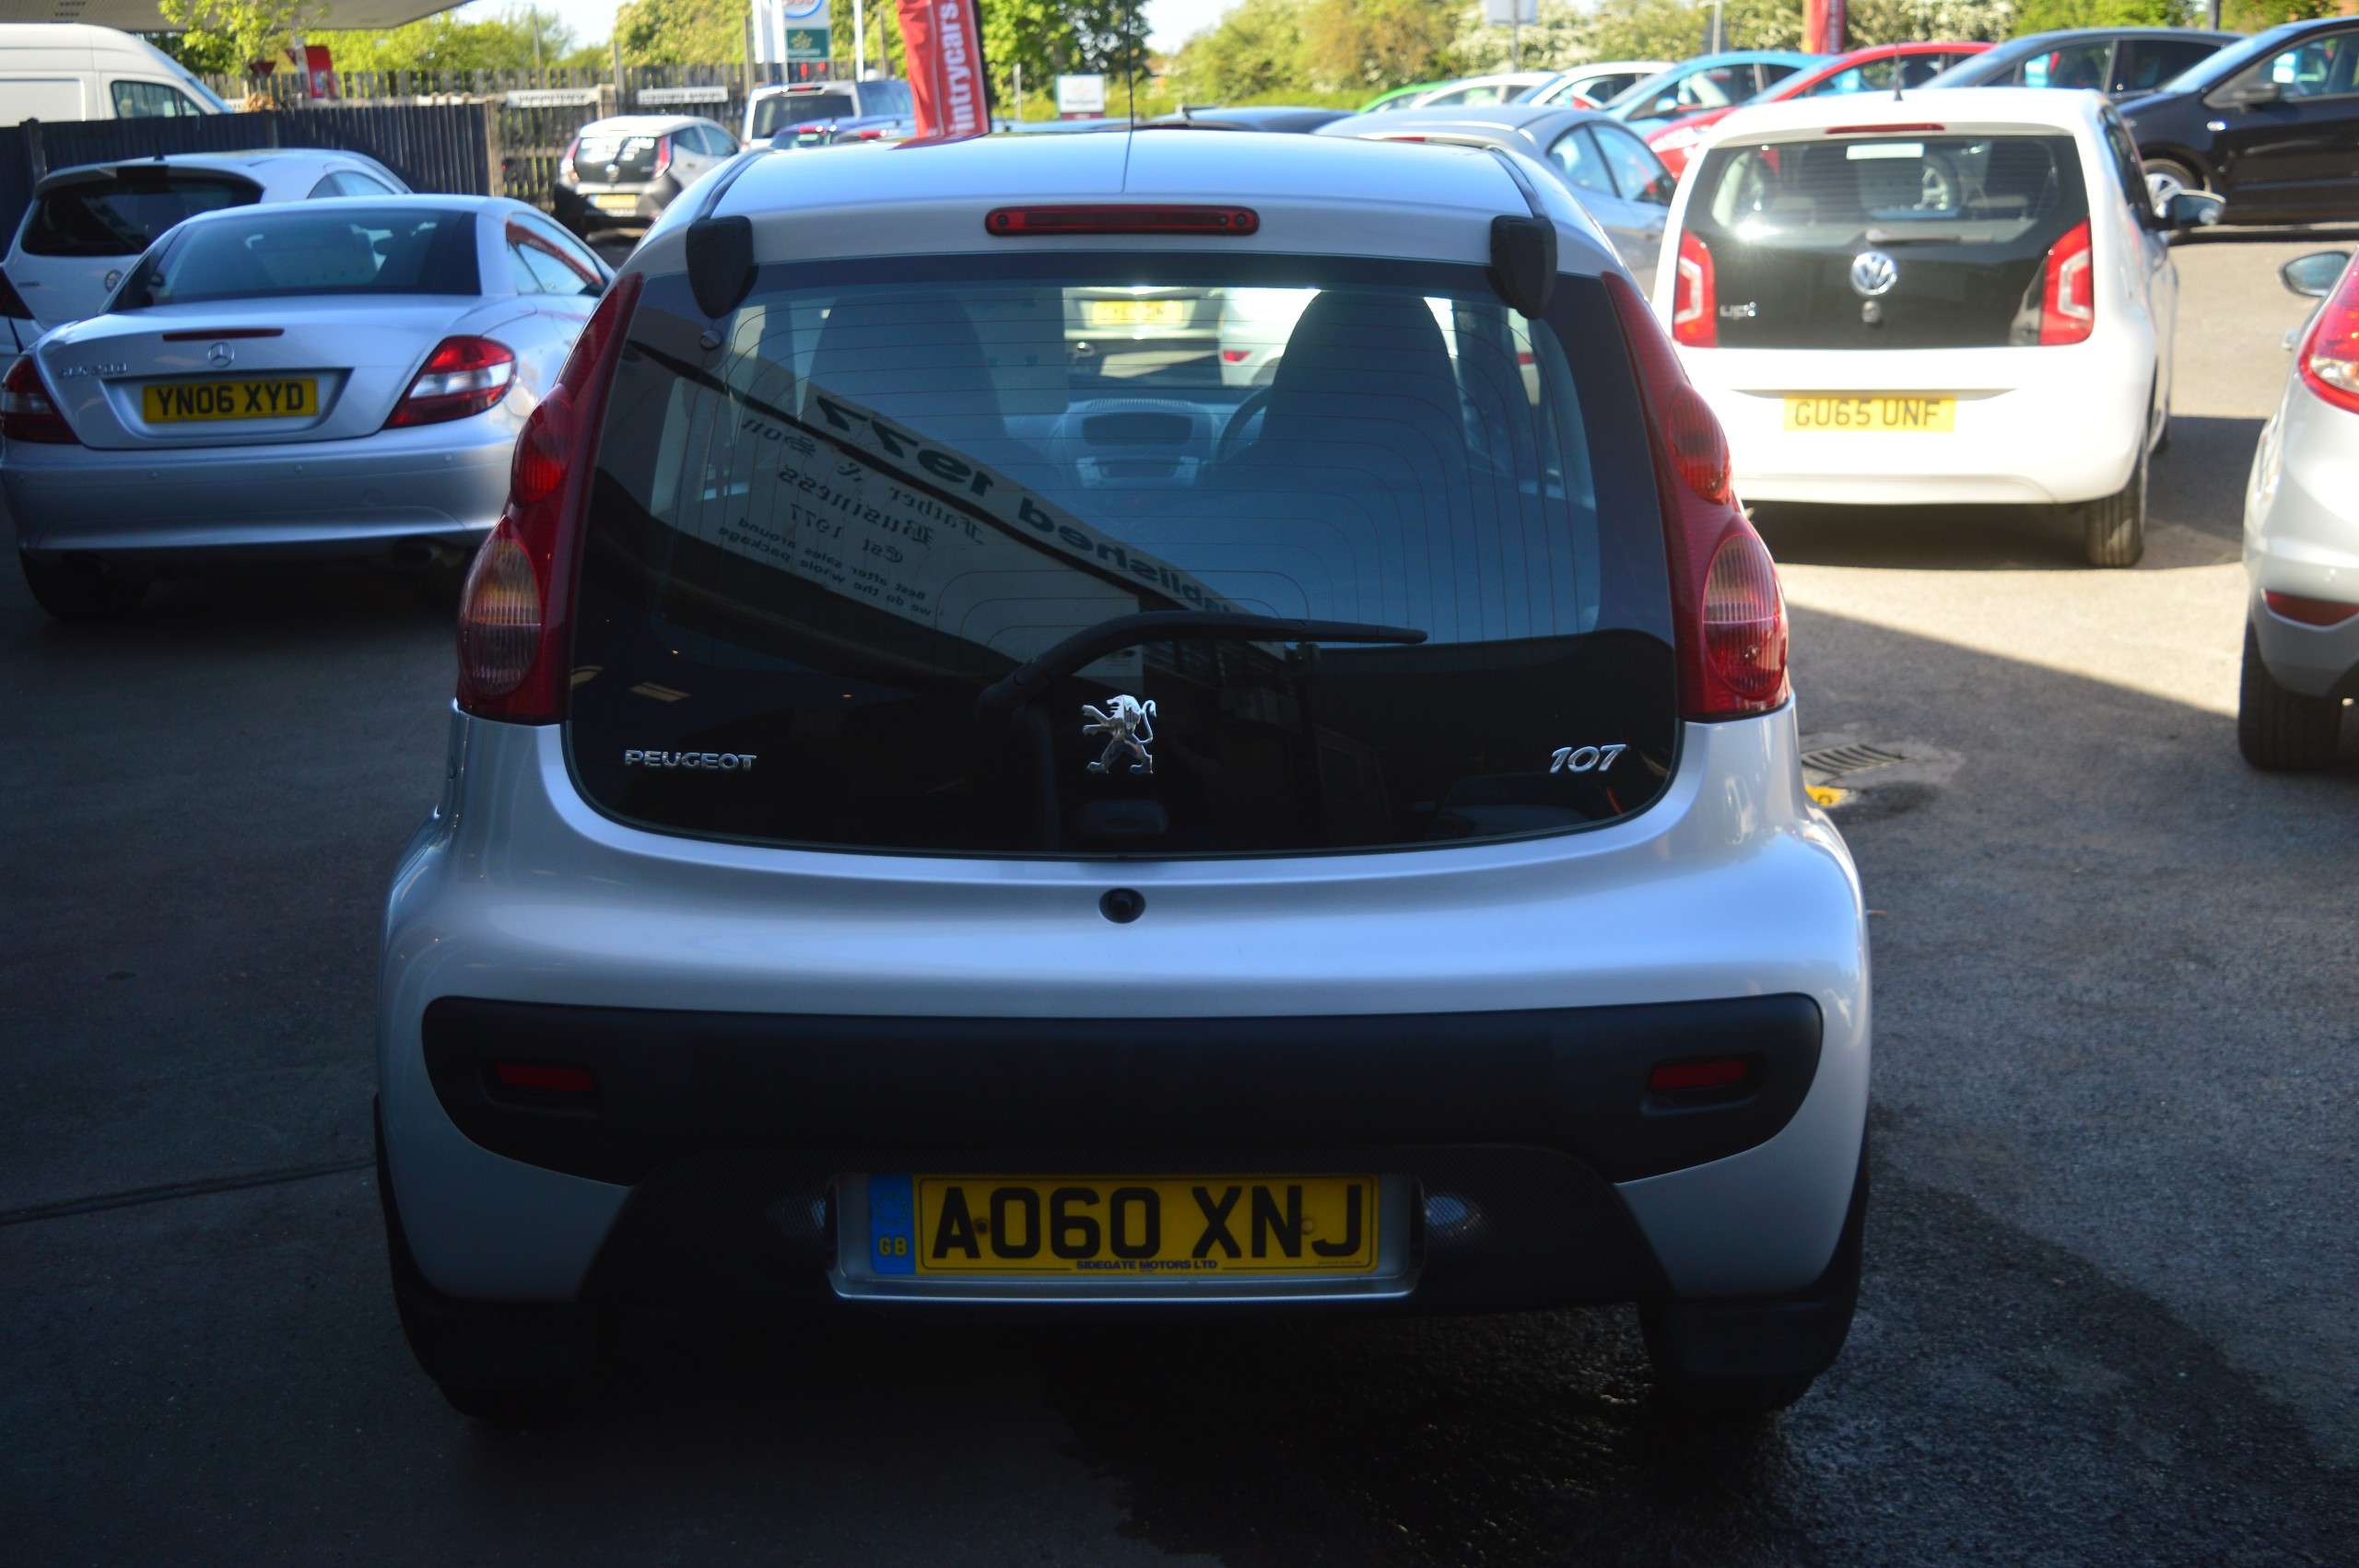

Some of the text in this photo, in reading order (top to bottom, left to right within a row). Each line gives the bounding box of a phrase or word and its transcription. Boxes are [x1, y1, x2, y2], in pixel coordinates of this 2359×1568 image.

[156, 381, 304, 415] YN06 XYD
[1795, 399, 1940, 427] GU65 UNF
[625, 749, 757, 770] PEUGEOT
[1549, 743, 1627, 774] 107
[932, 1185, 1363, 1259] AO60 XNJ
[878, 1236, 908, 1257] GB
[1075, 1259, 1218, 1270] SIDEGATE MOTORS LTD
